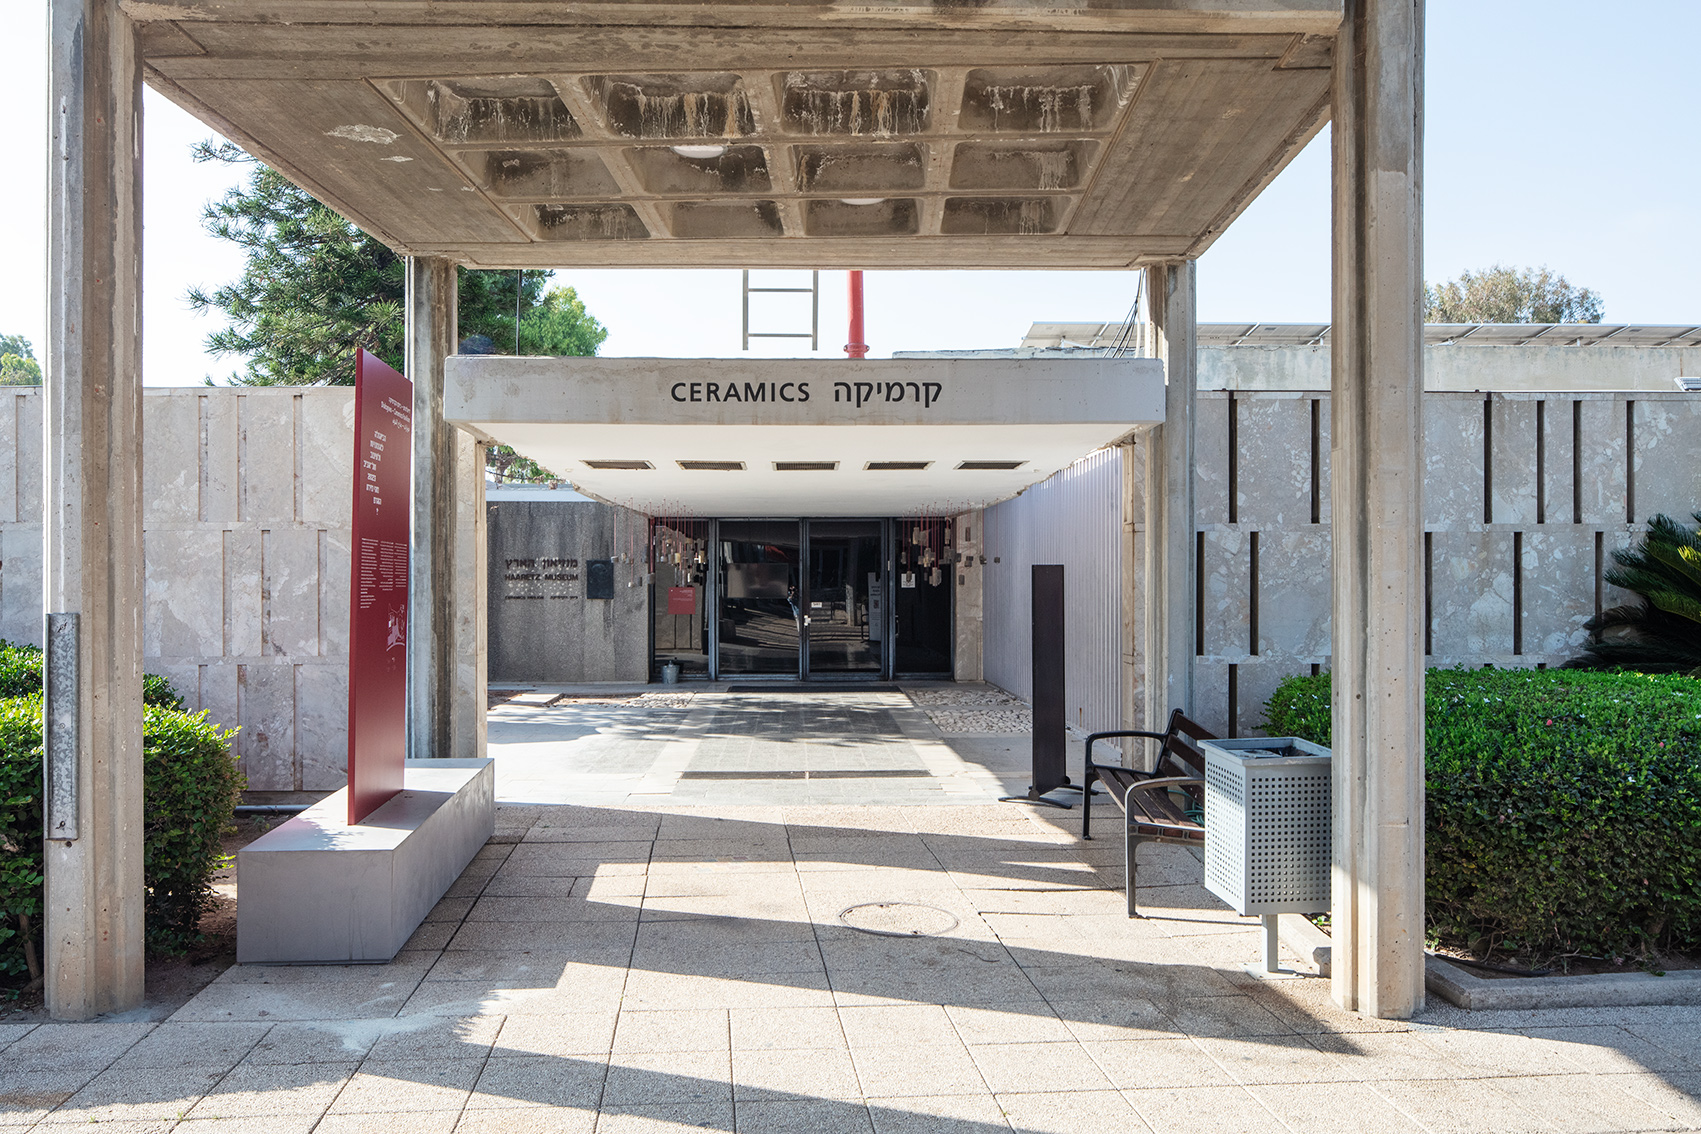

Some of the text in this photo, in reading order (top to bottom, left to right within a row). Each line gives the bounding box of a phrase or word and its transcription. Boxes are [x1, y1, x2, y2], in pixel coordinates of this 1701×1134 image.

[671, 382, 810, 402] CERAMICS
[834, 381, 942, 408] קרמיקה
[505, 558, 578, 569] מוזיאון הארץ
[505, 573, 579, 581] HAARETZ MUSEUM
